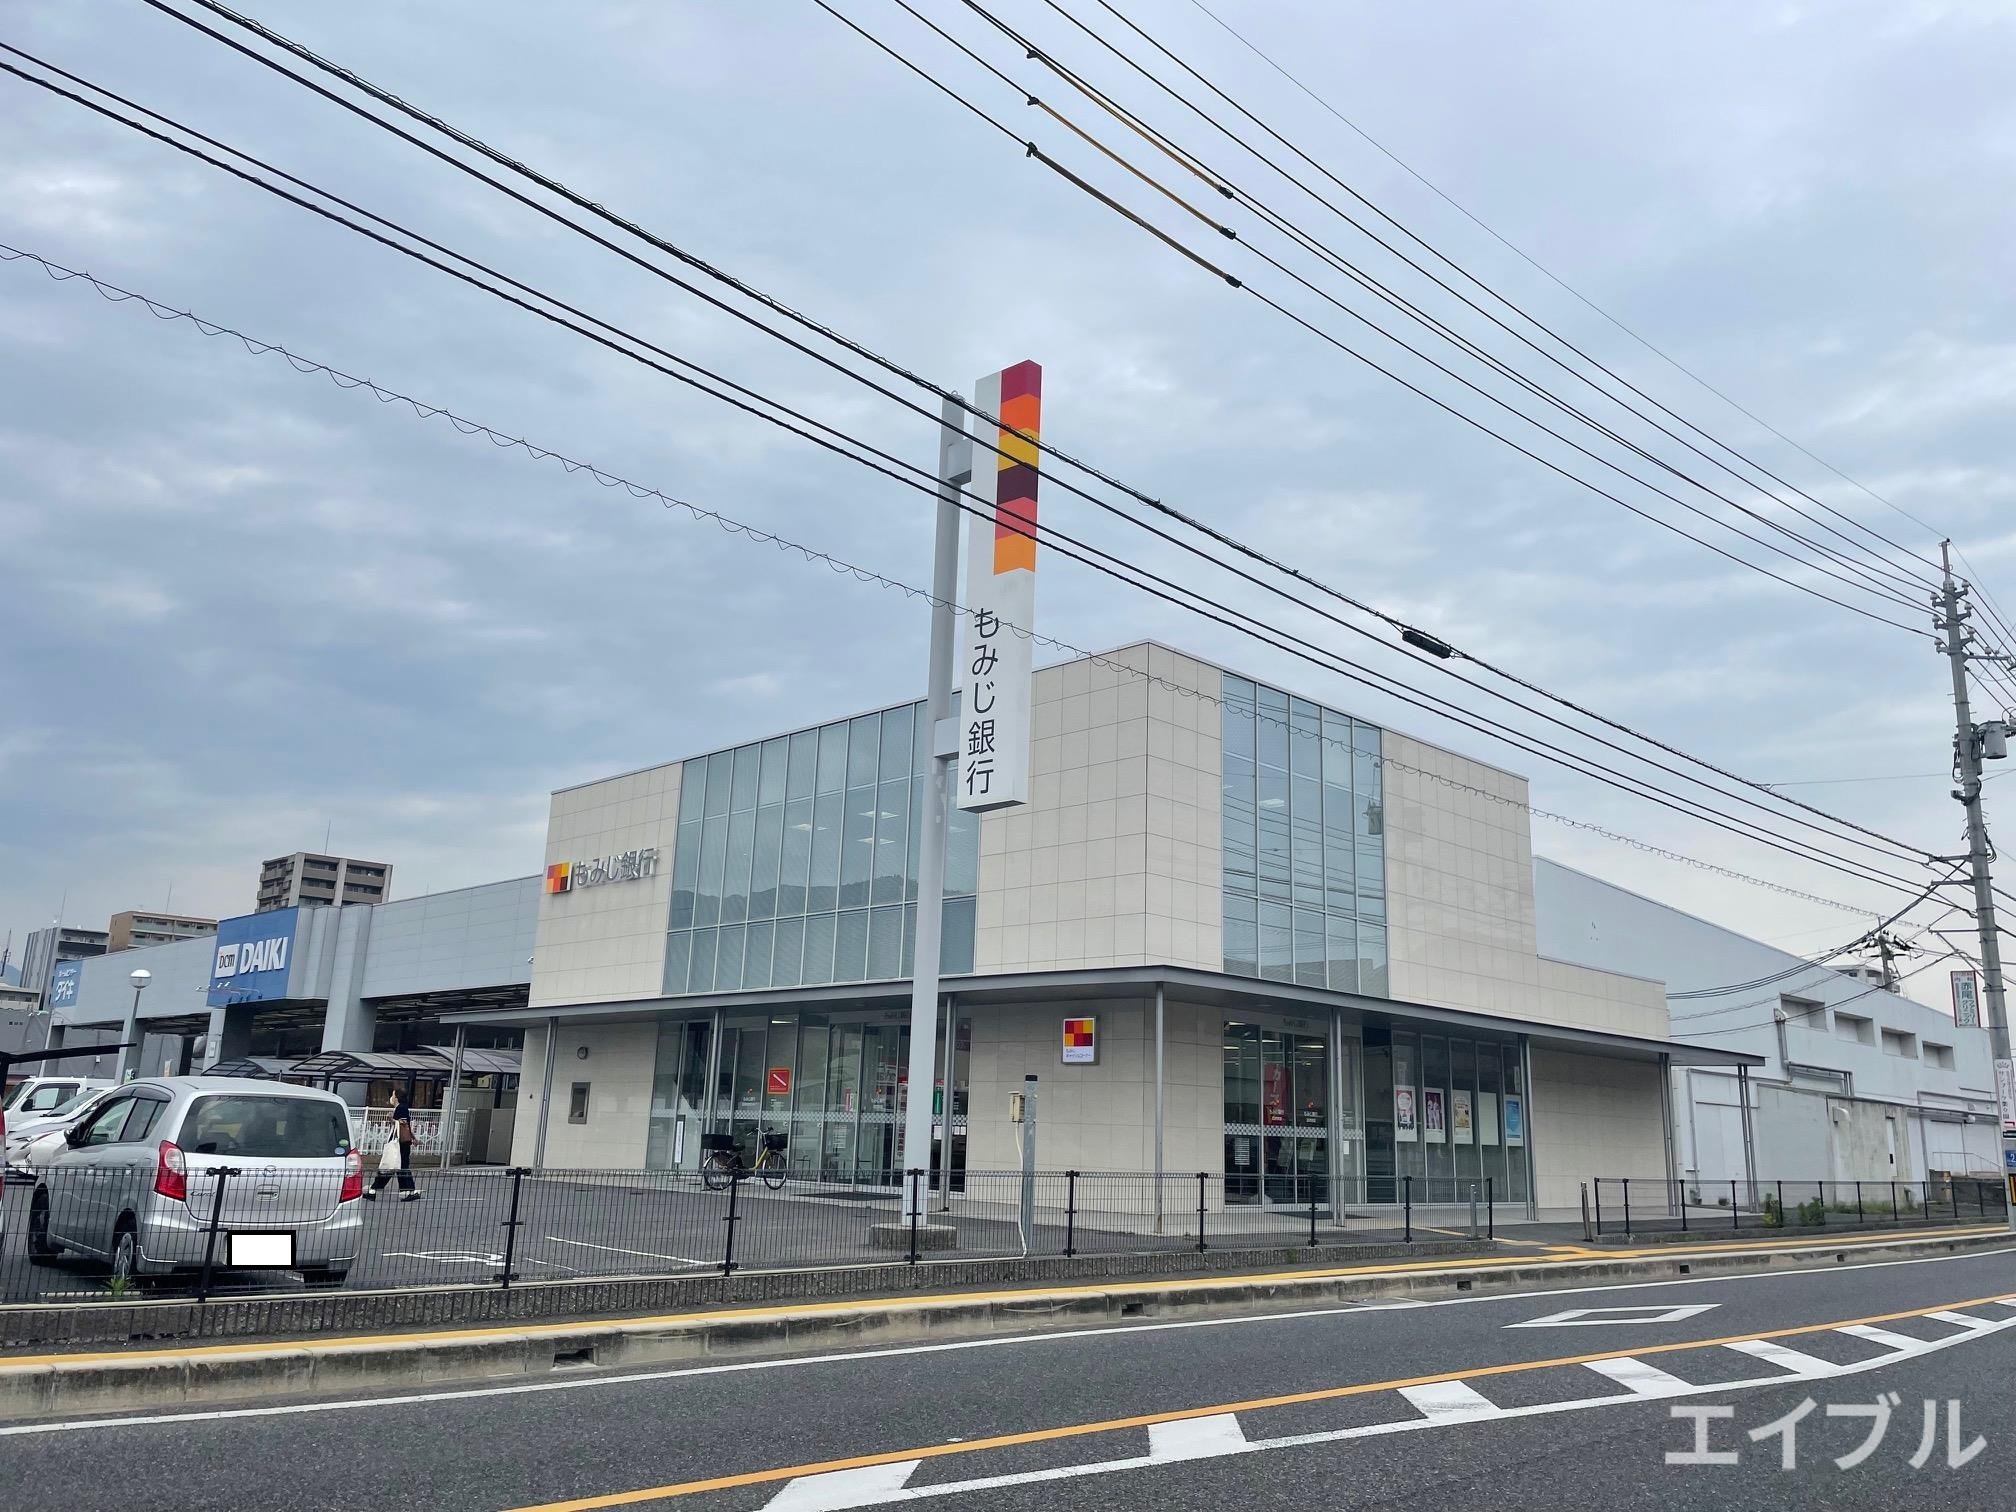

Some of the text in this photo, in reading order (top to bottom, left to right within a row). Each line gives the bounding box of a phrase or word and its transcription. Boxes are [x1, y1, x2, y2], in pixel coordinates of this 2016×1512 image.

[966, 607, 999, 796] もみじ銀行
[576, 848, 659, 886] もみじ銀行
[239, 937, 288, 975] DAIKI
[55, 979, 75, 1001] ダイキ
